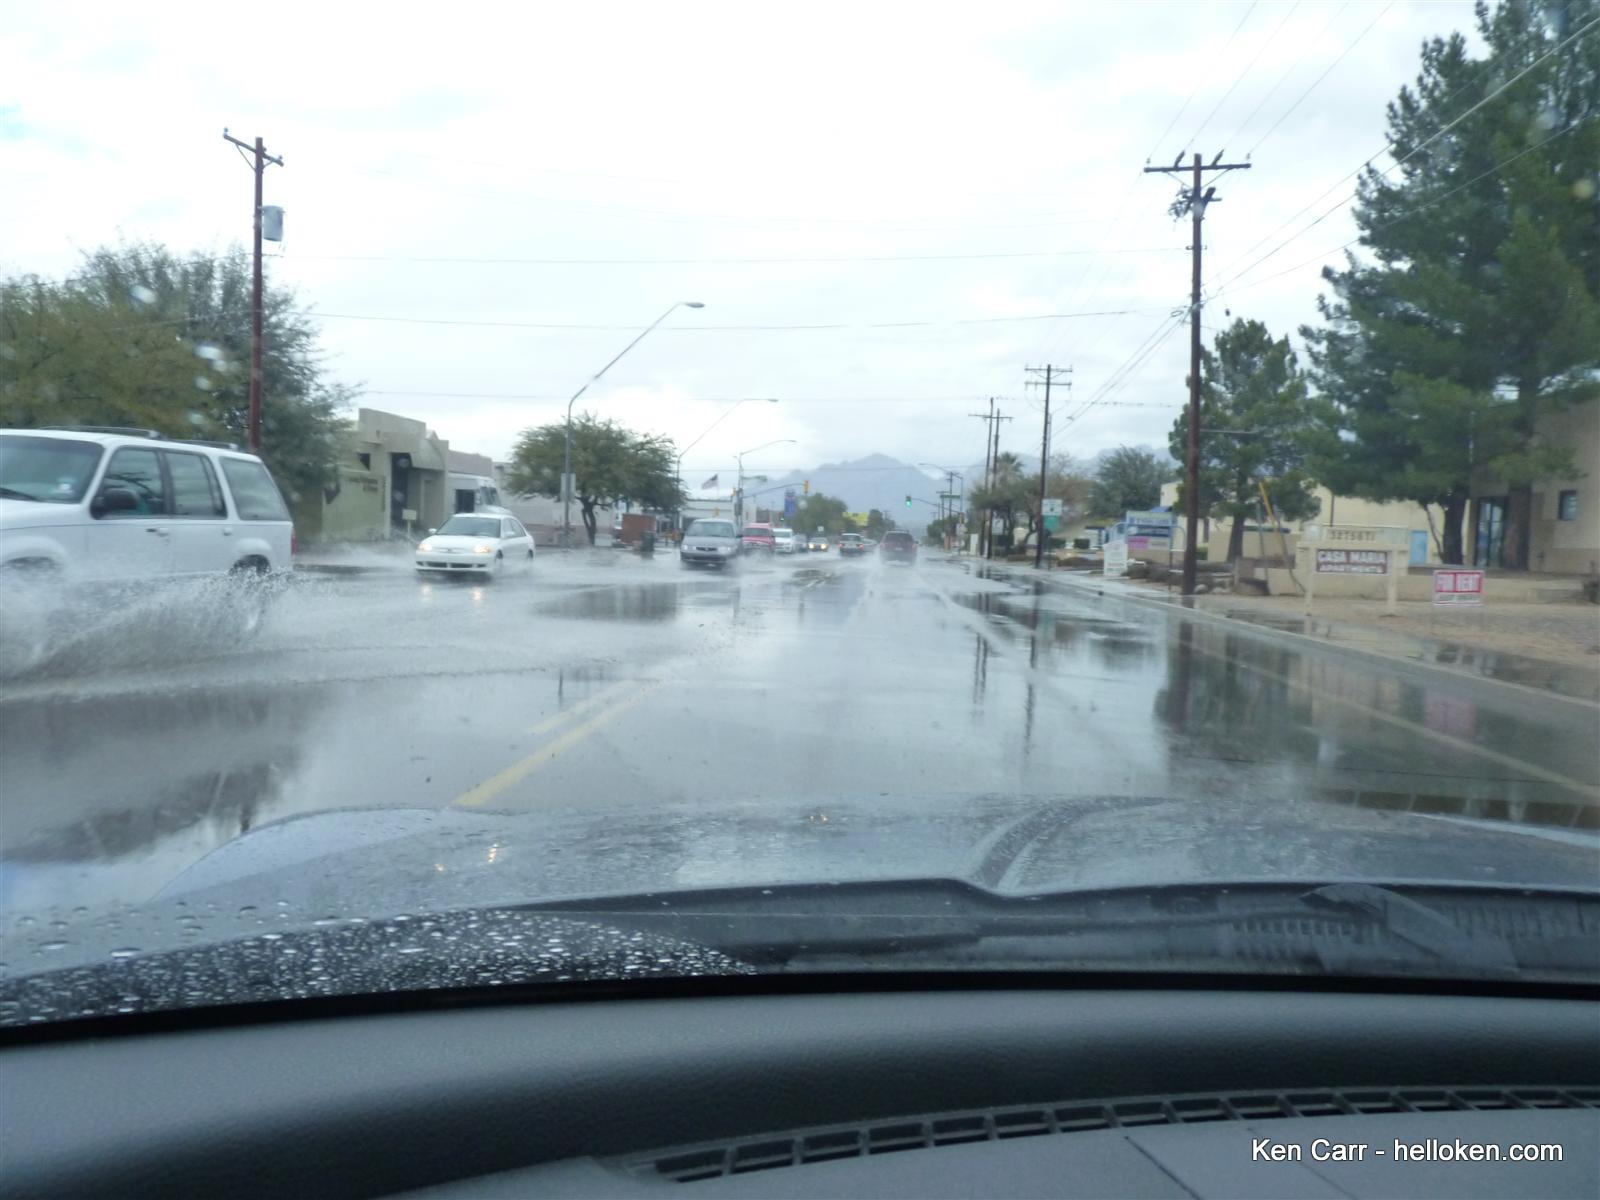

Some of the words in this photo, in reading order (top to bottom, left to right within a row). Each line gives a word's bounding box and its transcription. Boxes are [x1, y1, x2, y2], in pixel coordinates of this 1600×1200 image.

[1318, 550, 1346, 563] CASA
[1350, 551, 1386, 564] MARIA
[1436, 573, 1454, 592] FOR
[1456, 573, 1480, 592] RENT
